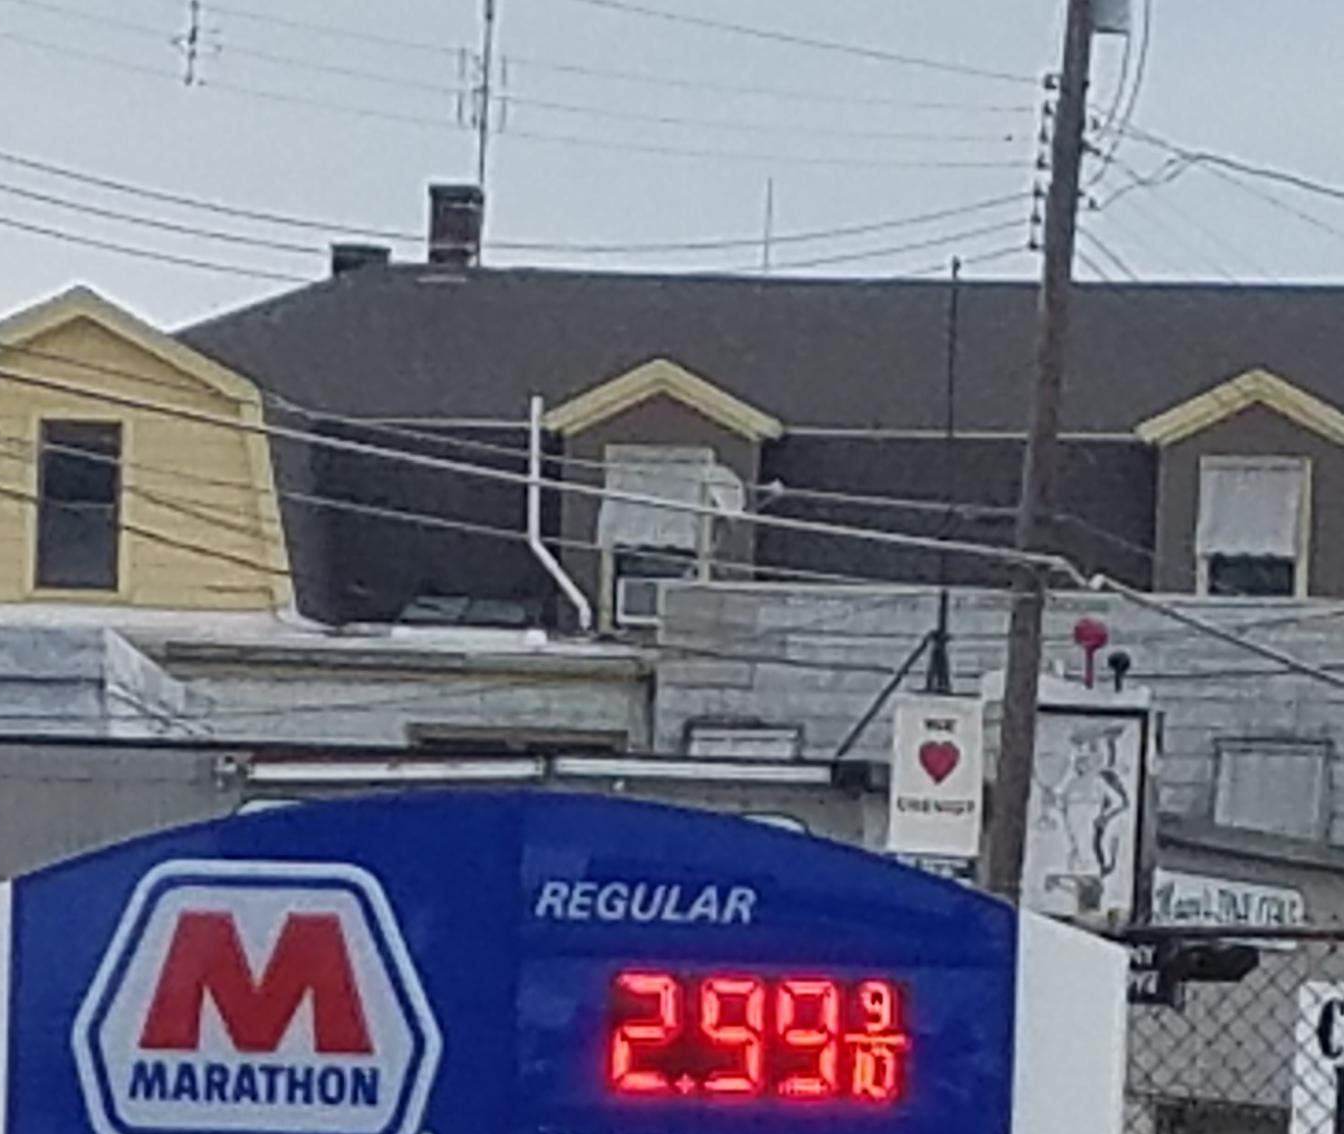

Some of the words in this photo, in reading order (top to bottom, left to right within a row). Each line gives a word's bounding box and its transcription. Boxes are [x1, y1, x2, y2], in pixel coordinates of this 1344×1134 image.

[534, 882, 756, 925] REGULAR
[611, 972, 840, 1096] 2.99
[129, 1061, 380, 1107] MARATHON
